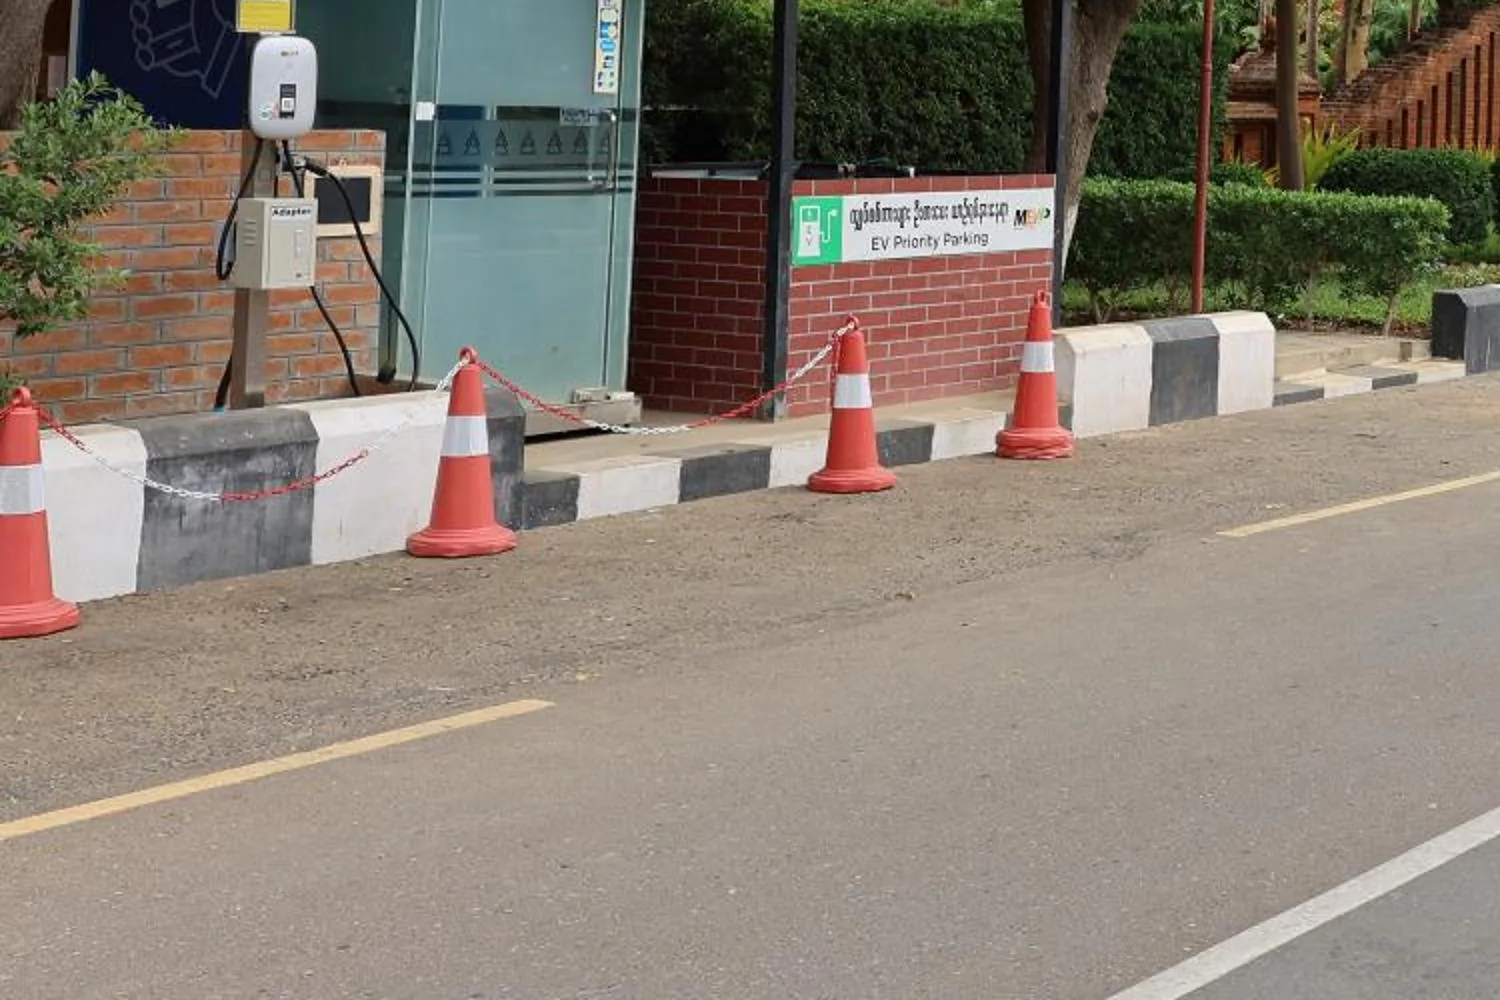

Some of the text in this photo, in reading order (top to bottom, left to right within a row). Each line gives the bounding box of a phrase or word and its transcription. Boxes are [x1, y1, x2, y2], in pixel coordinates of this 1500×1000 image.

[871, 231, 990, 252] EV Priority Parking
